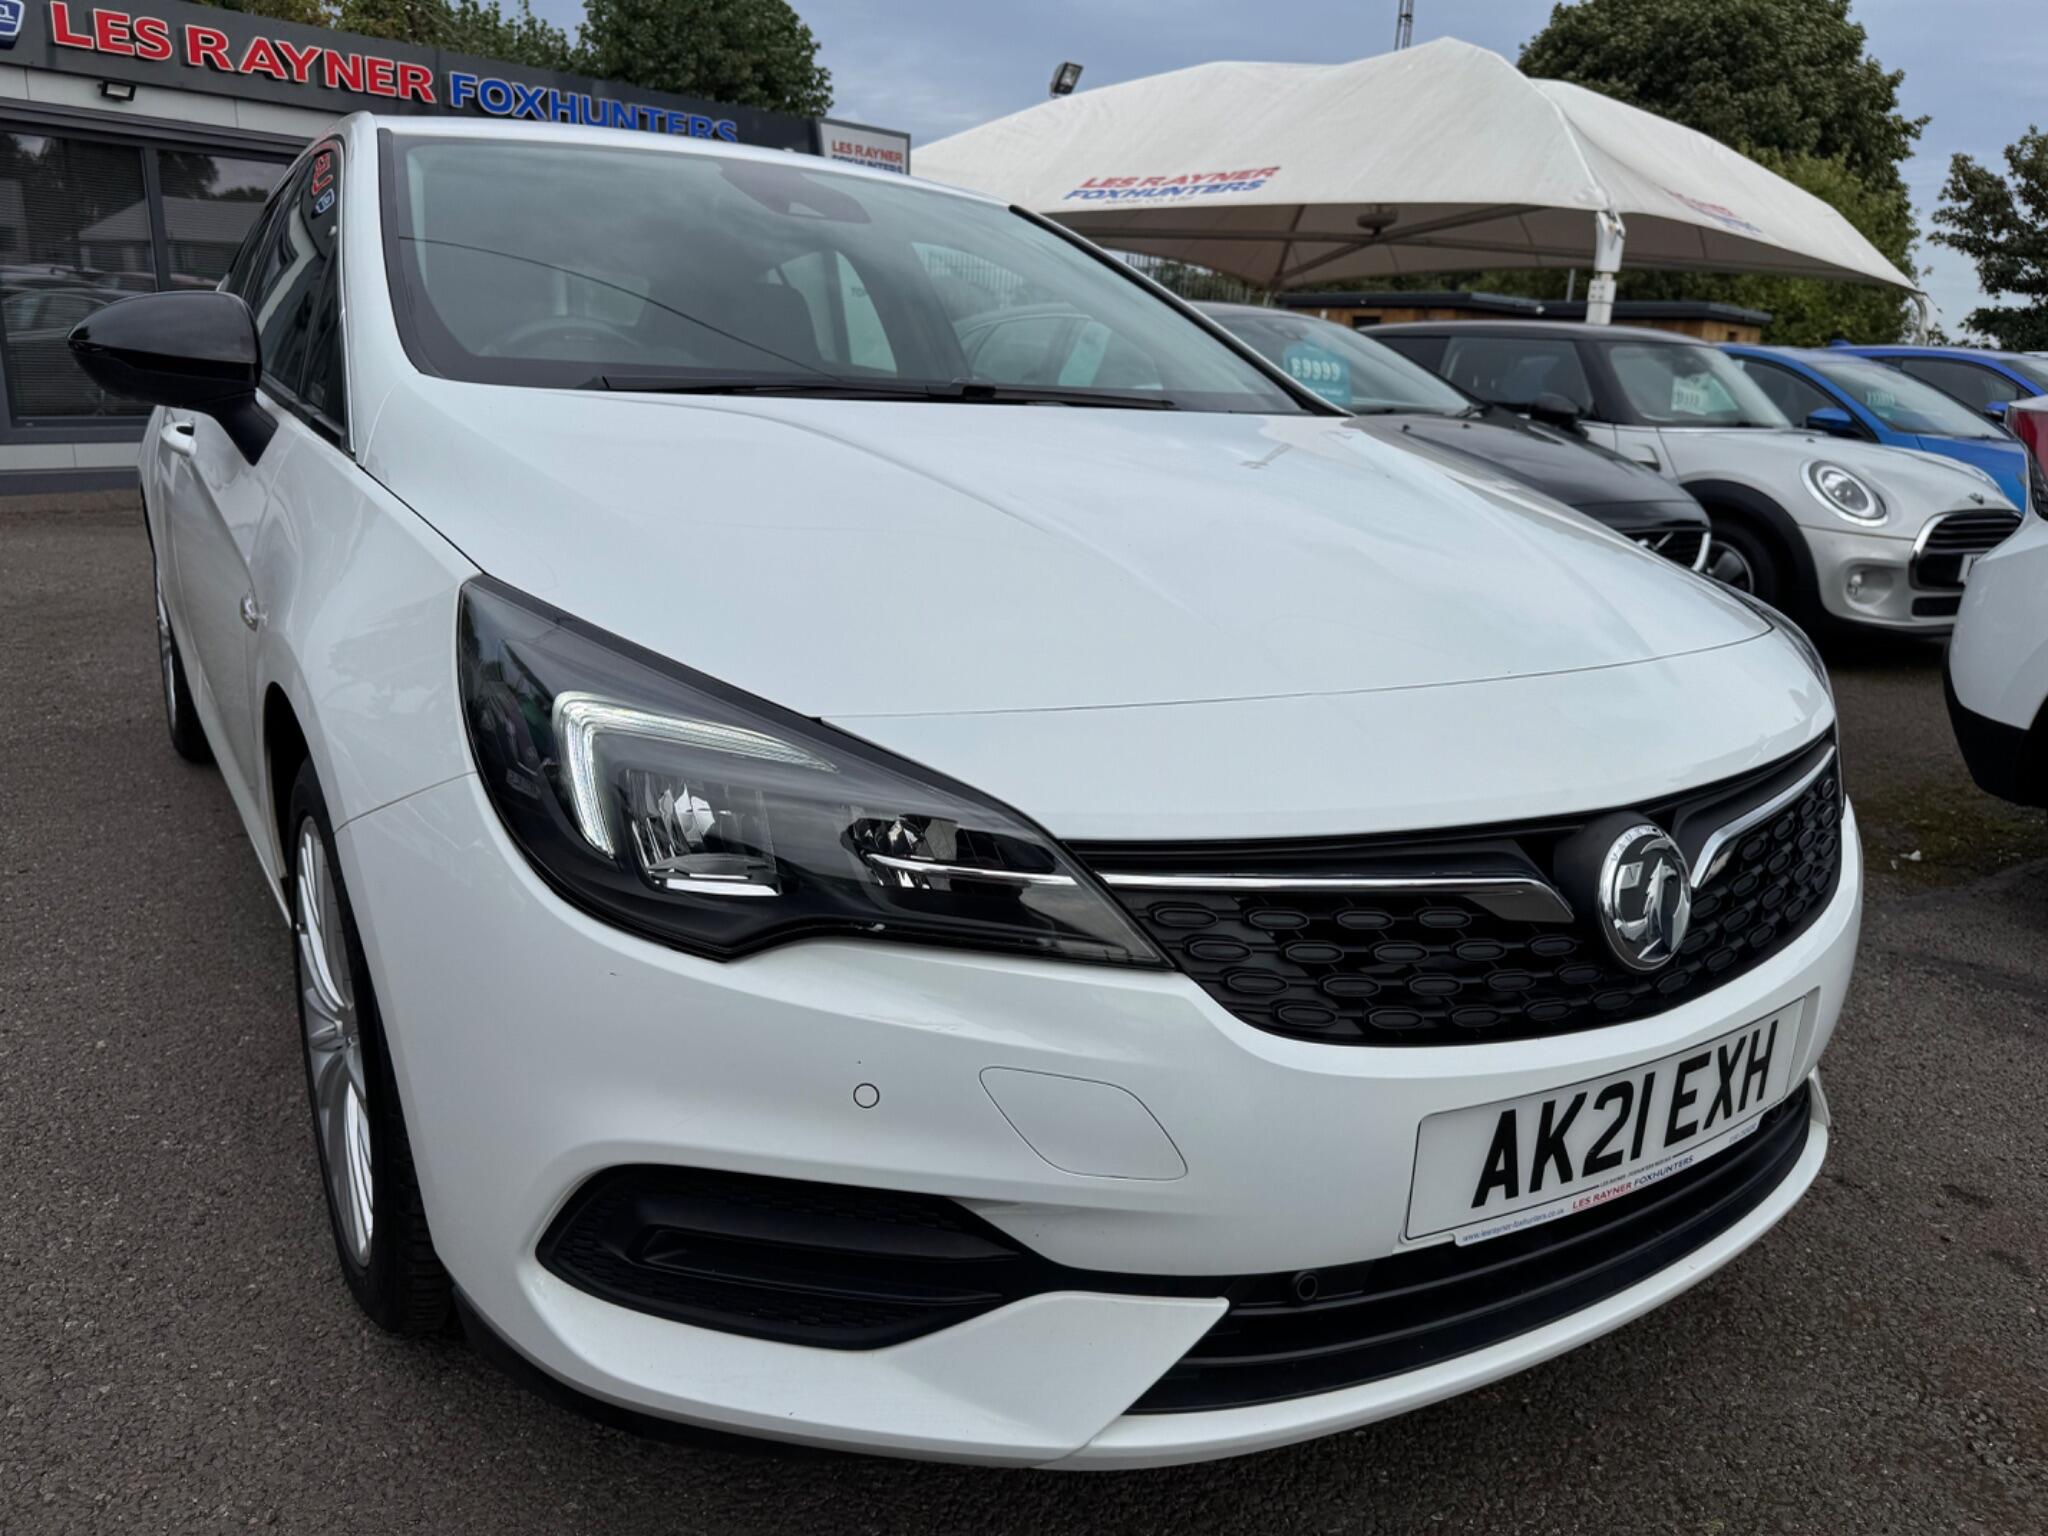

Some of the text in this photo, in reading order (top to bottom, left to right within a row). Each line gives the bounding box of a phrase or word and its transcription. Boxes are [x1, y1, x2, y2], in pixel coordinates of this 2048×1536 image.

[50, 1, 738, 142] LES RAYNER FOXHUNTERS
[832, 141, 903, 163] LES RAYNER
[1063, 179, 1266, 200] FOXHUNTERS
[1080, 166, 1281, 188] LES RAYNER
[1470, 1020, 1779, 1209] AK21 EXH
[1572, 1196, 1591, 1210] LES
[1592, 1182, 1632, 1202] RAYNER
[1634, 1154, 1694, 1187] FOXHUNTERS
